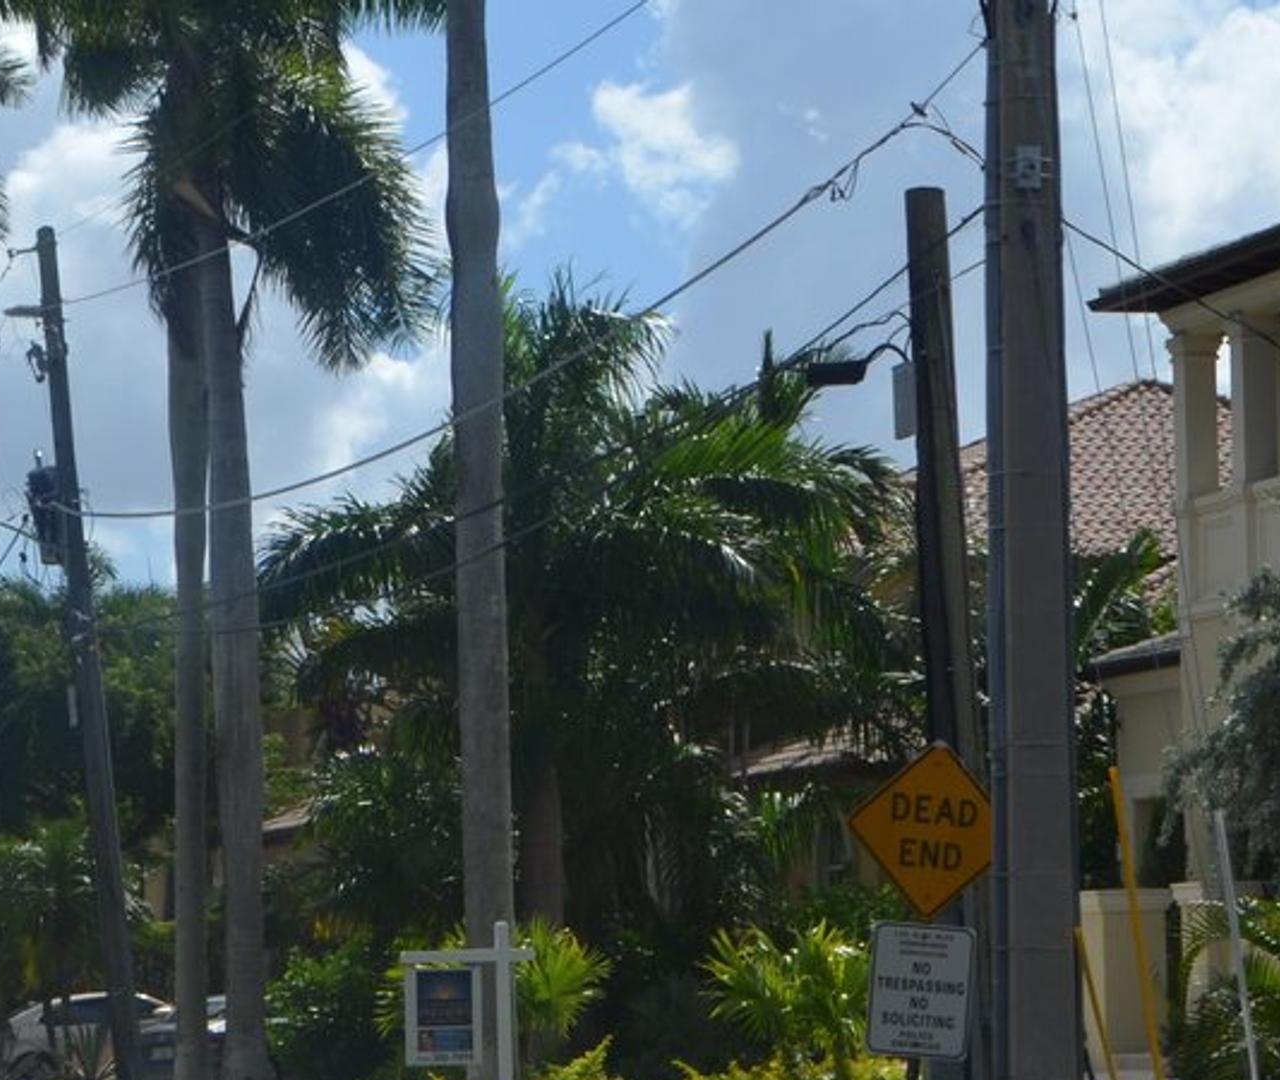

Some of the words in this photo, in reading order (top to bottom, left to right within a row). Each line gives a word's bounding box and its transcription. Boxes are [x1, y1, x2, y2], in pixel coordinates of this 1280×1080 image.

[891, 792, 978, 828] DEAD
[899, 838, 962, 871] END
[911, 961, 932, 976] NO
[877, 976, 965, 996] TRESPASSING
[908, 996, 929, 1010] NO
[881, 1011, 956, 1030] SOLICITING
